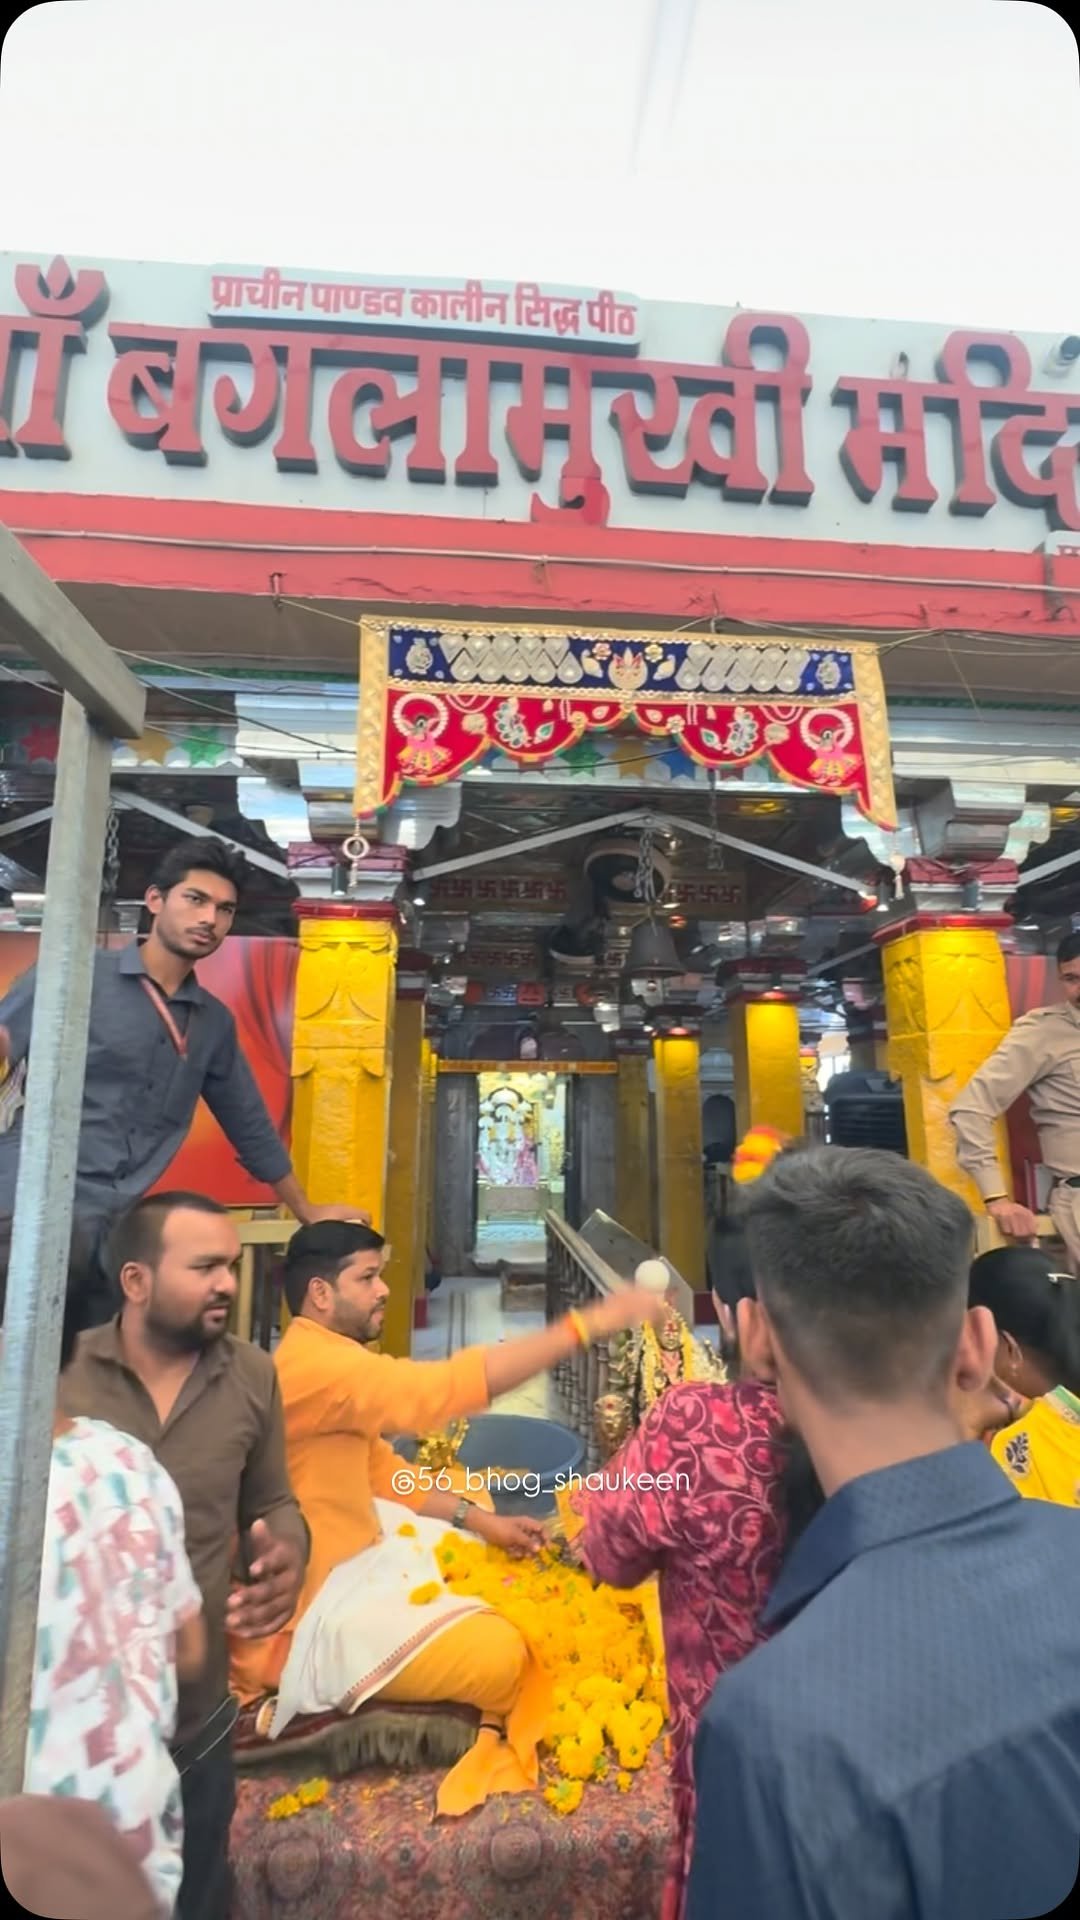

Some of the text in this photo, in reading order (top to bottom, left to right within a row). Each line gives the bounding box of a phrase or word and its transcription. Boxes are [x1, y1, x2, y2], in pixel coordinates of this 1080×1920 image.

[211, 266, 637, 336] प्राचीन पाण्डव कालीन सिद्ध पीठ
[107, 312, 815, 527] बगलामुखी
